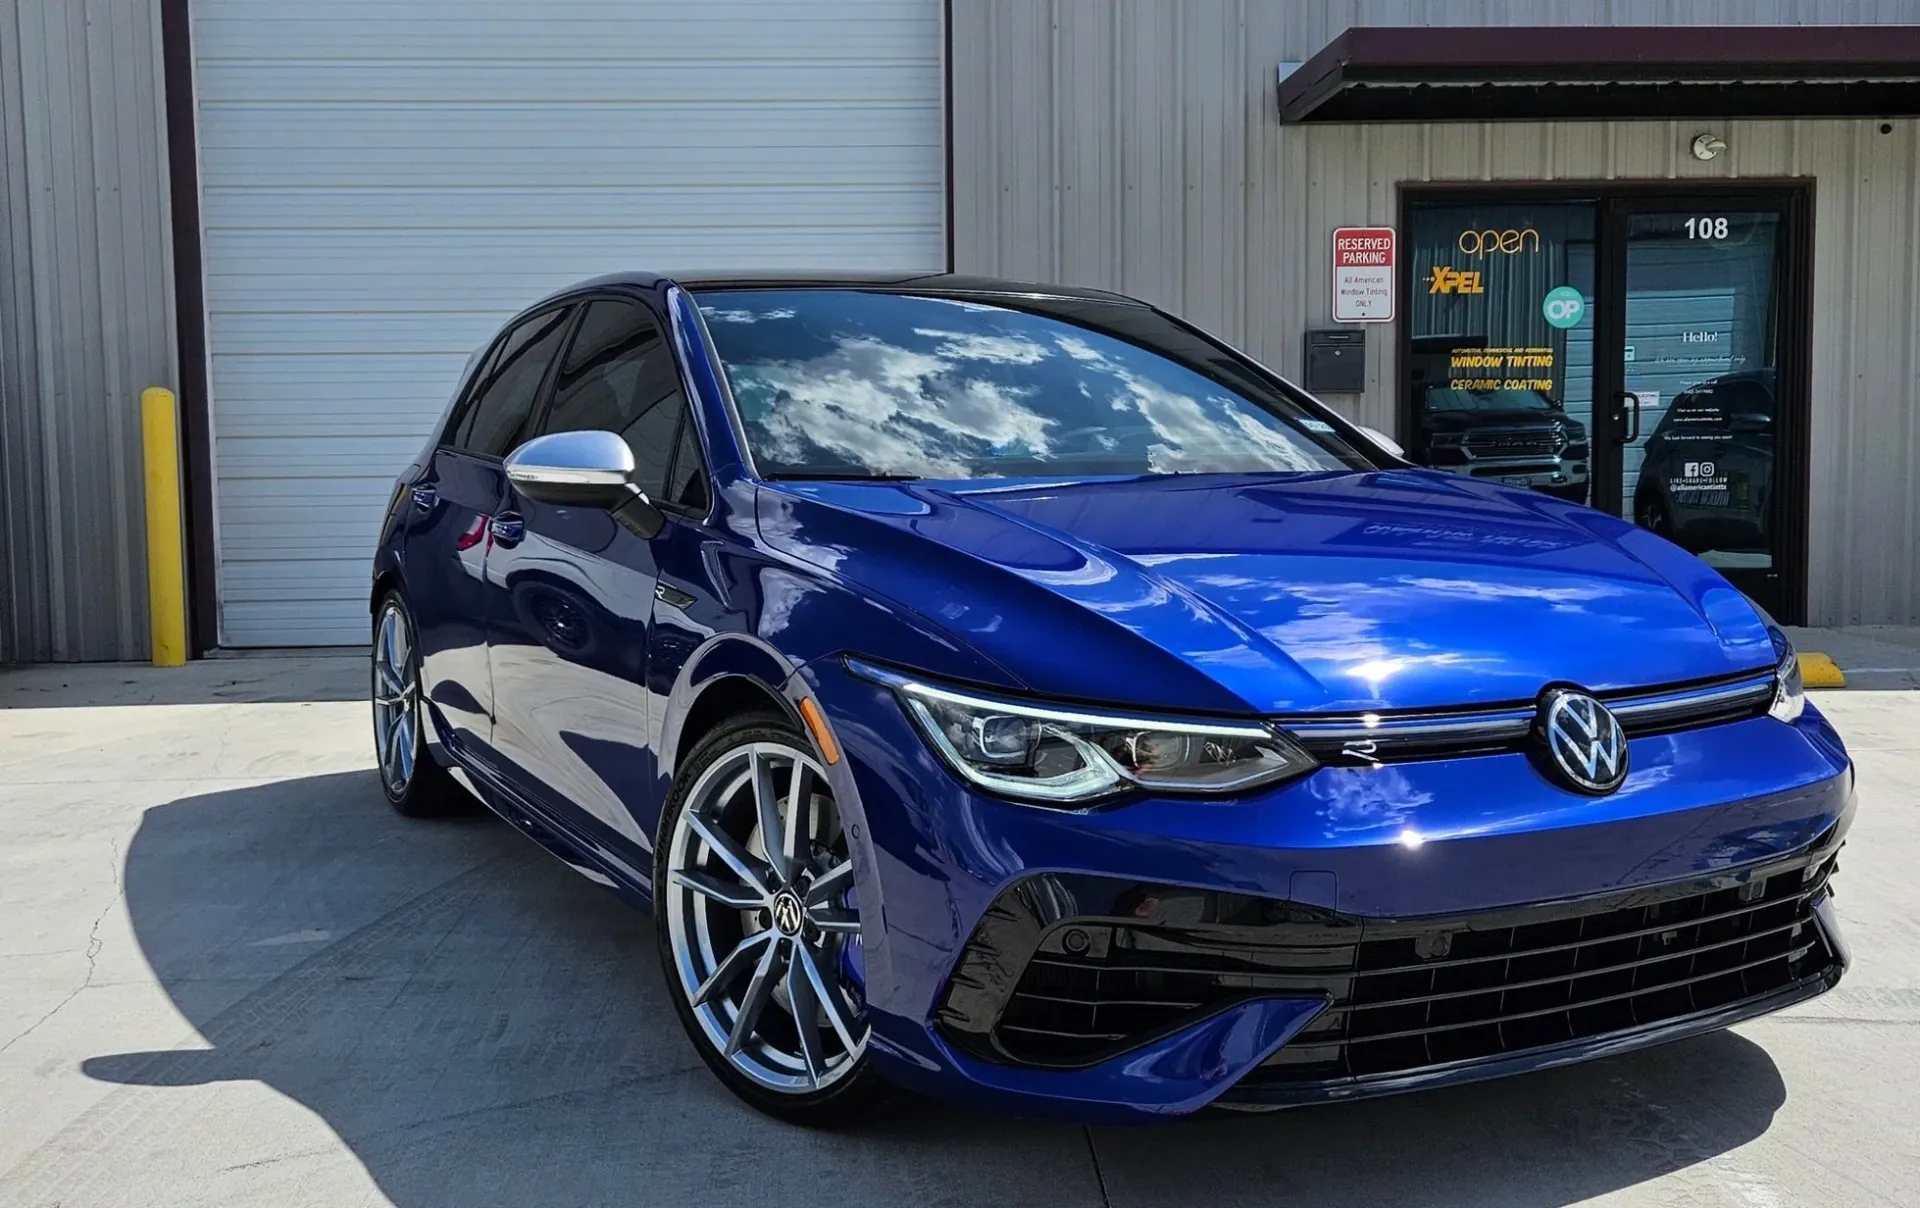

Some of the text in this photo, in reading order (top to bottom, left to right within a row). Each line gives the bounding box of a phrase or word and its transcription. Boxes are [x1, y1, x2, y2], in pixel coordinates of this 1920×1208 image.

[1684, 217, 1729, 239] 108
[1338, 238, 1391, 250] RESERVED
[1459, 229, 1539, 260] open
[1343, 252, 1386, 264] PARKING
[1344, 276, 1384, 284] All American
[1429, 266, 1484, 294] XPEL
[1366, 288, 1388, 296] Tinting
[1547, 300, 1581, 320] OP
[1683, 331, 1718, 342] Hello!
[1451, 355, 1553, 368] WINDOW TINTING
[1450, 379, 1553, 390] CERAMIC COATING
